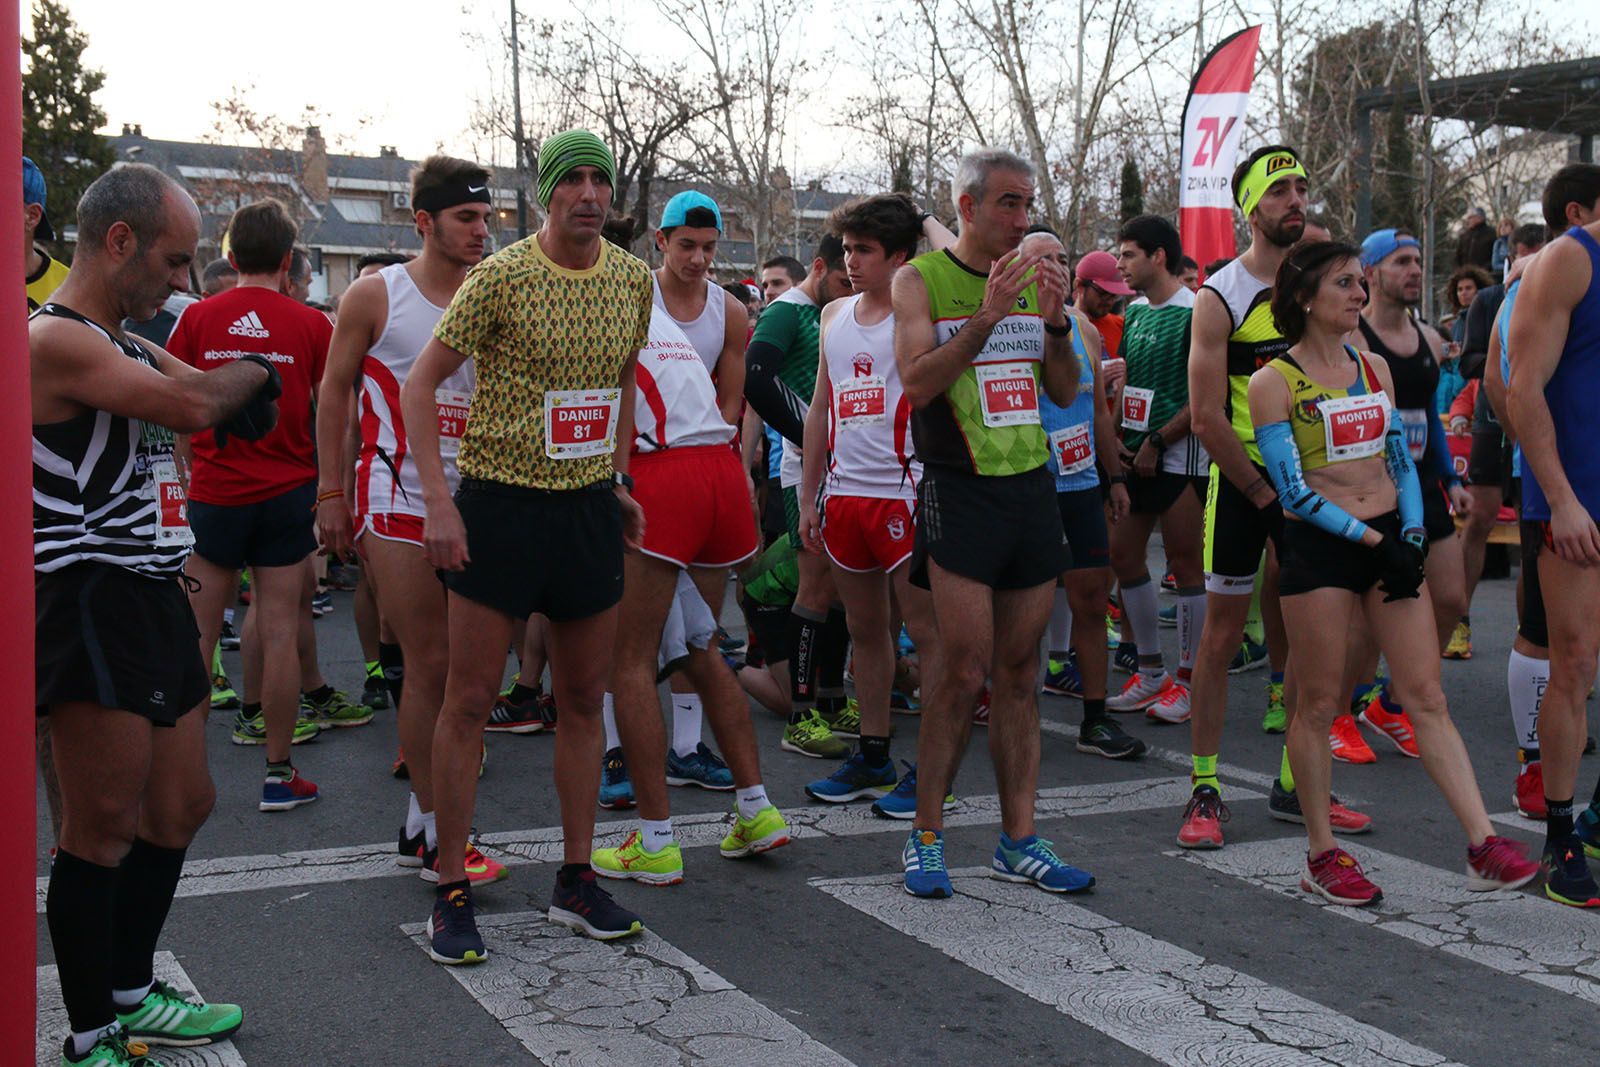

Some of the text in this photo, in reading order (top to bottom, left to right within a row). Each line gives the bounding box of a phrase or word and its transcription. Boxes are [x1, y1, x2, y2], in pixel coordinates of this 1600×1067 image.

[1211, 176, 1228, 190] VIP
[228, 326, 270, 338] adidas
[990, 380, 1031, 393] MIGUEL
[843, 390, 880, 402] ERNEST
[1006, 394, 1024, 408] 14
[437, 406, 469, 420] AVIER
[853, 402, 868, 413] 22
[558, 408, 605, 422] DANIEL
[1336, 408, 1380, 425] MONTSE
[441, 420, 457, 435] 21
[573, 424, 591, 439] 81
[1355, 424, 1365, 440] 7
[1074, 447, 1085, 459] 91
[166, 485, 185, 501] PED
